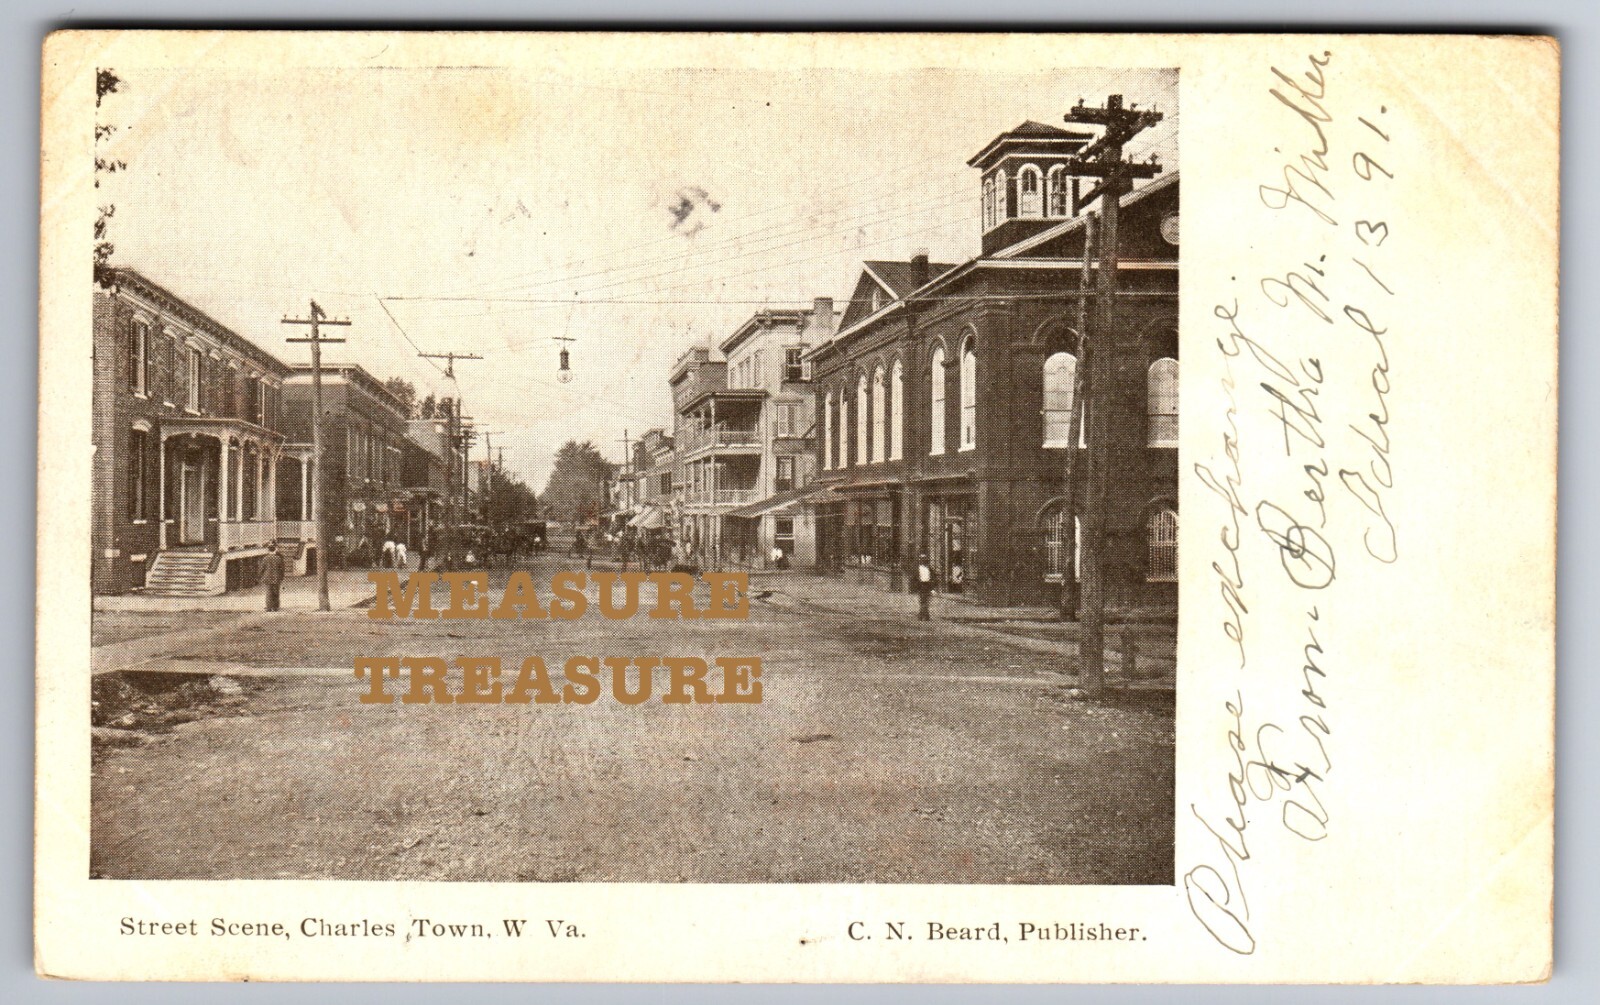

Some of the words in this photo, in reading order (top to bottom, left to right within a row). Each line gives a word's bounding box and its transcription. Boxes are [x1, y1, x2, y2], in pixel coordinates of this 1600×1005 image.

[1256, 357, 1337, 589] Bertha
[1184, 689, 1256, 955] Please
[119, 917, 199, 937] Street
[211, 918, 291, 940] Scene,
[300, 918, 395, 937] Charles
[546, 919, 587, 938] Va.
[847, 921, 872, 941] C.
[886, 922, 912, 941] N.
[927, 922, 1009, 943] Beard,
[1018, 922, 1148, 941] Publisher.
